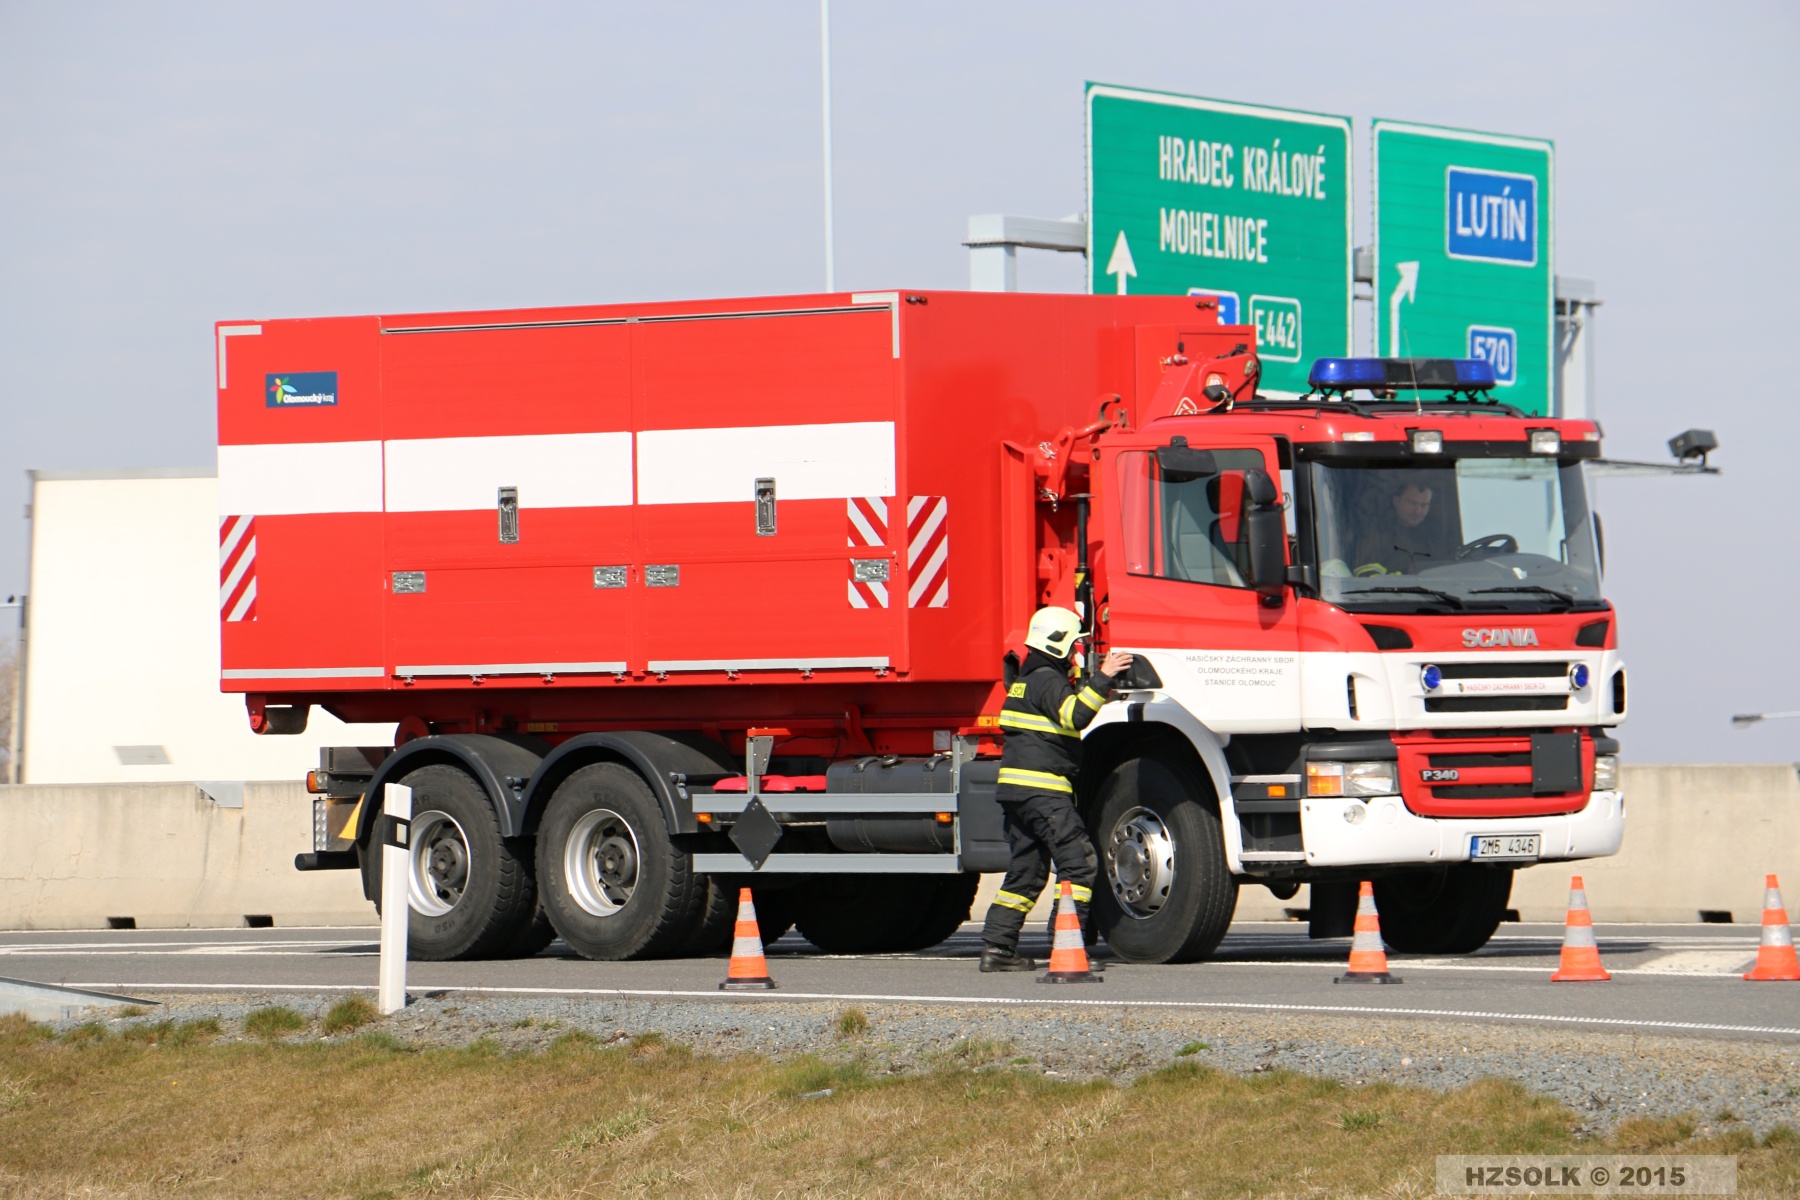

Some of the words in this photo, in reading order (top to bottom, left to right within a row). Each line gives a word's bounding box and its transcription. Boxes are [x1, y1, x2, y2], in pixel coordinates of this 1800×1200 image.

[1159, 135, 1234, 188] HRADEC
[1243, 138, 1326, 199] KRÁLOVÉ
[1456, 186, 1526, 242] LUTÍN
[1160, 207, 1268, 263] MOHELNICE
[283, 393, 322, 404] Olomoucký
[1462, 628, 1539, 648] SCANIA
[1481, 839, 1500, 855] 2M5
[1508, 838, 1534, 854] 4346
